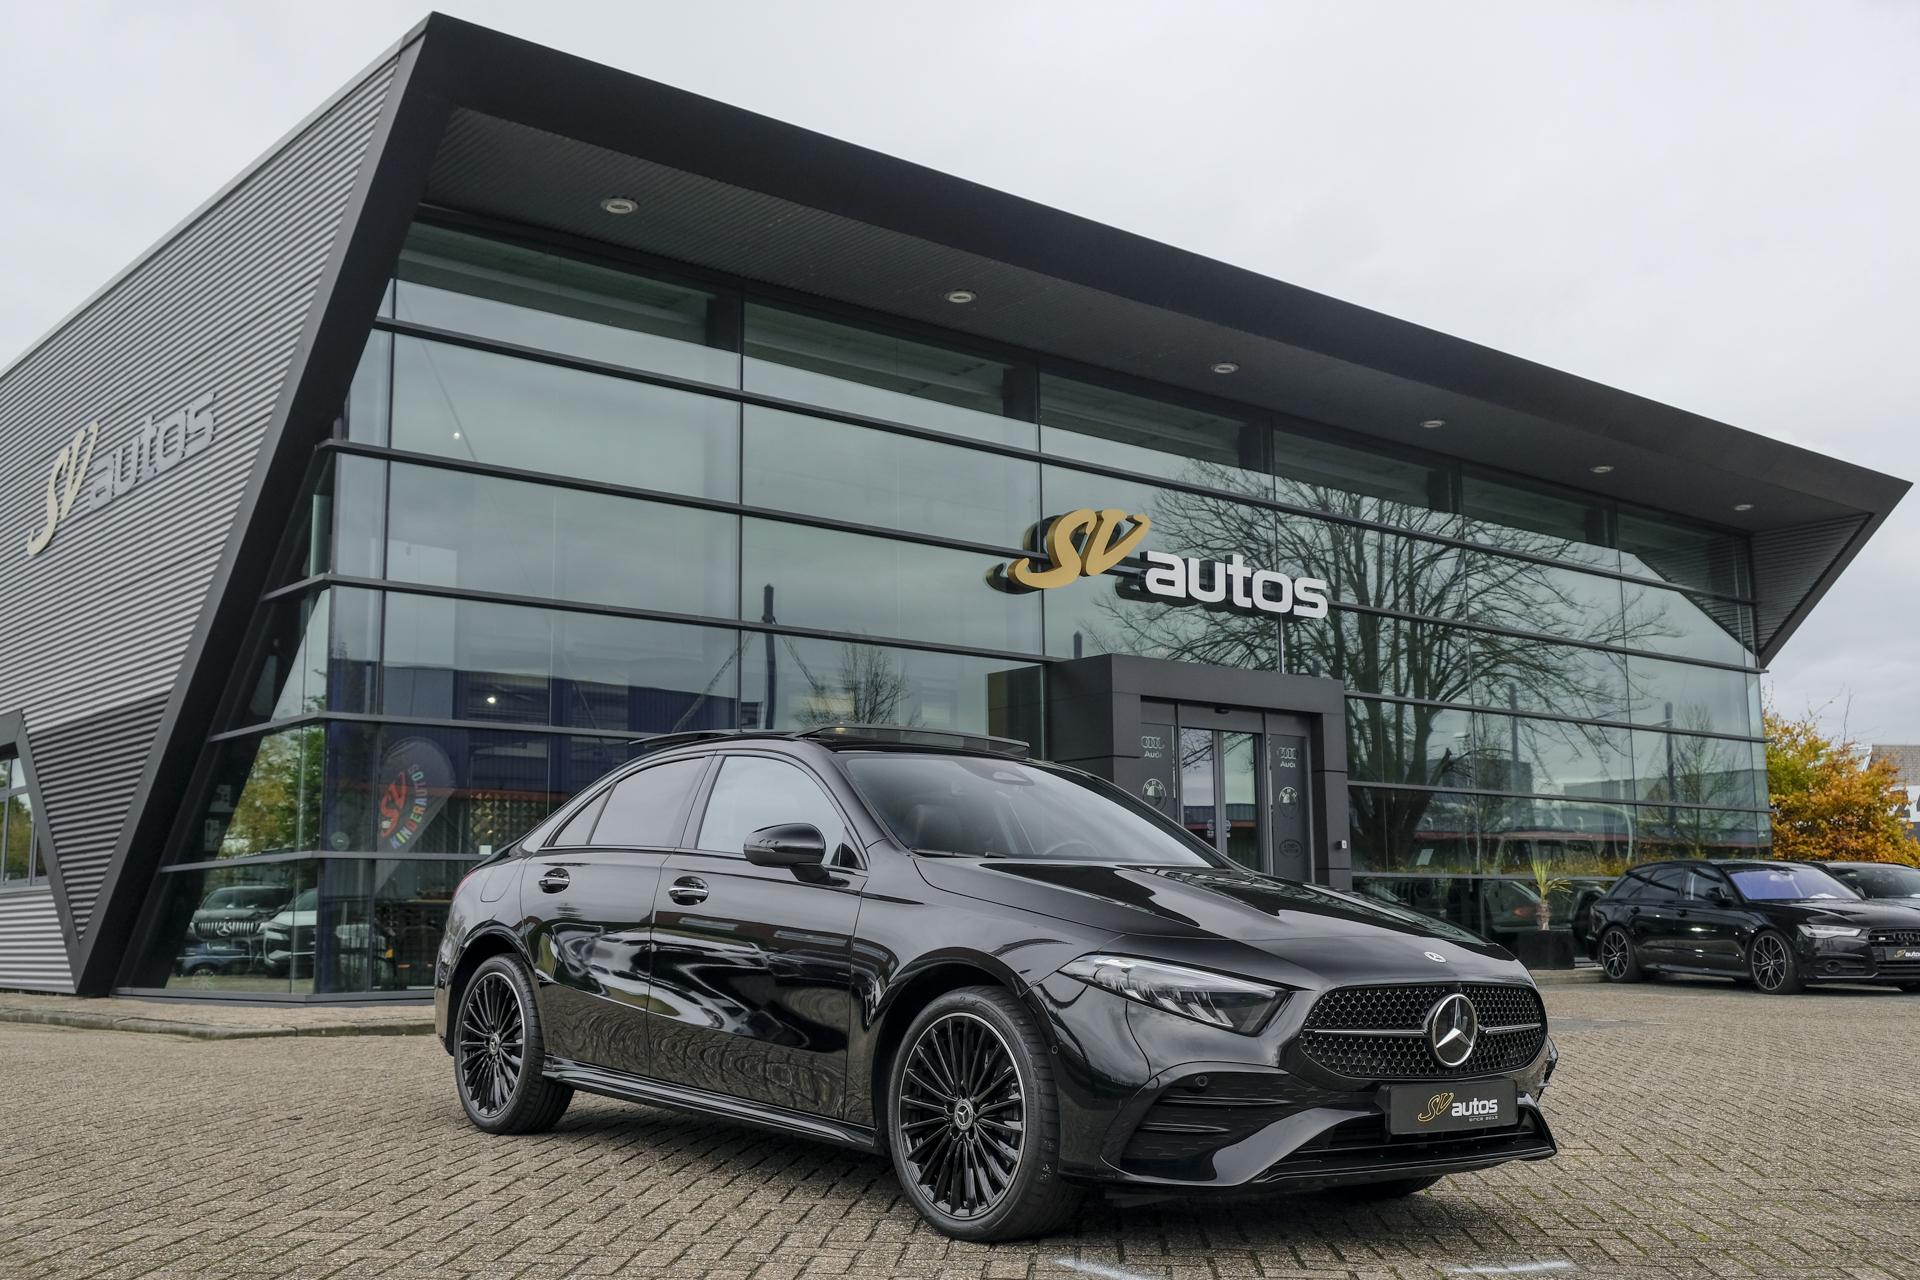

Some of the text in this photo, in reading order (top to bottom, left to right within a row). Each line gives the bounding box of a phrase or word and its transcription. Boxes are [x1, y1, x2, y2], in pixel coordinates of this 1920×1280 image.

[89, 391, 216, 510] autos
[1008, 508, 1328, 619] SV autos
[1451, 1097, 1498, 1117] autos
